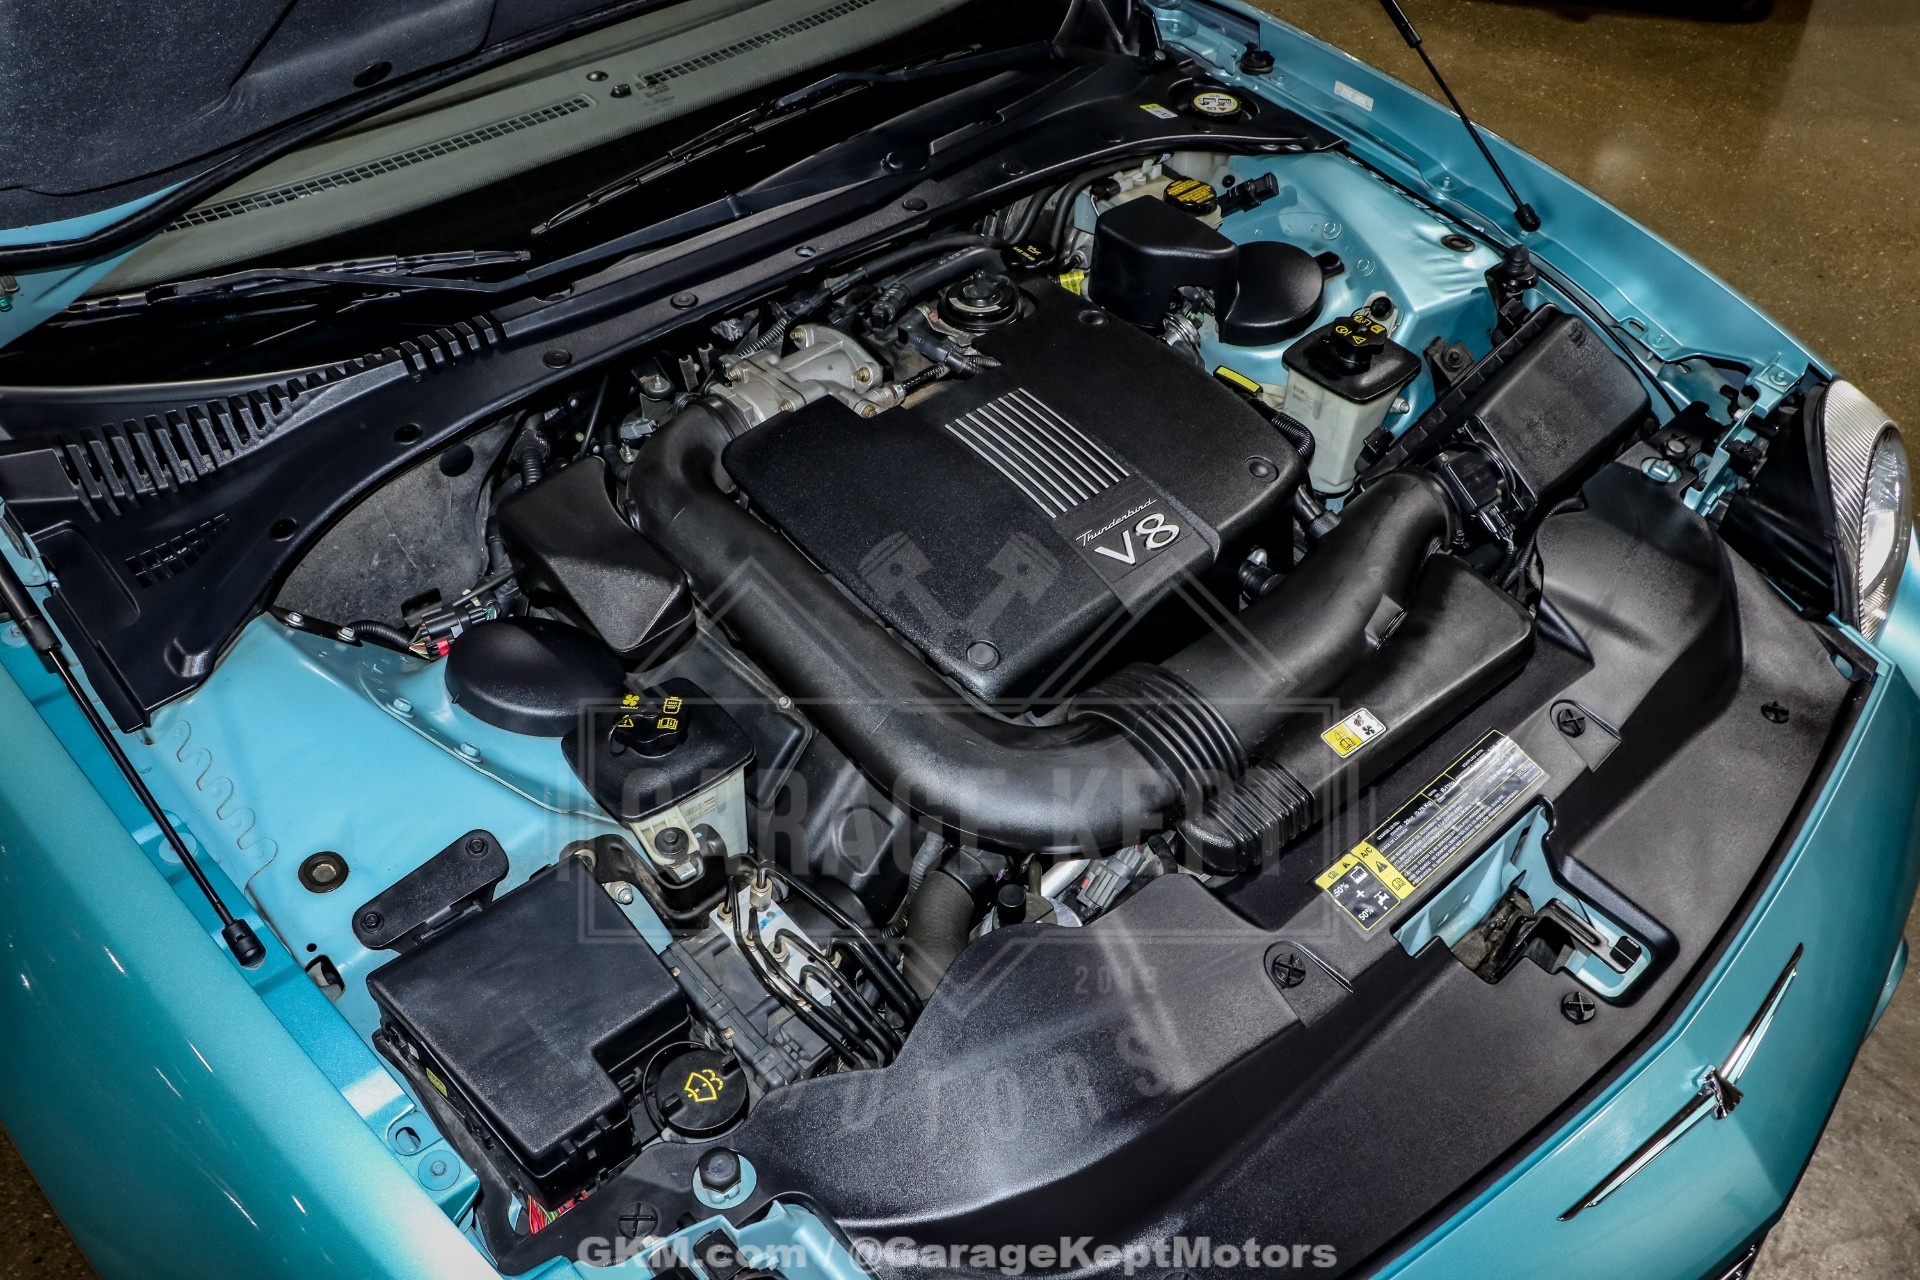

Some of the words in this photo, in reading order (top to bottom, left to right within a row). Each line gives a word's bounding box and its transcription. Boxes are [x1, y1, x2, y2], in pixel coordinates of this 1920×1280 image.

[1075, 498, 1157, 547] Thunderbird
[1094, 513, 1180, 566] V8
[1360, 846, 1373, 859] A/C
[1333, 882, 1350, 898] 50%
[1358, 907, 1374, 921] 50%
